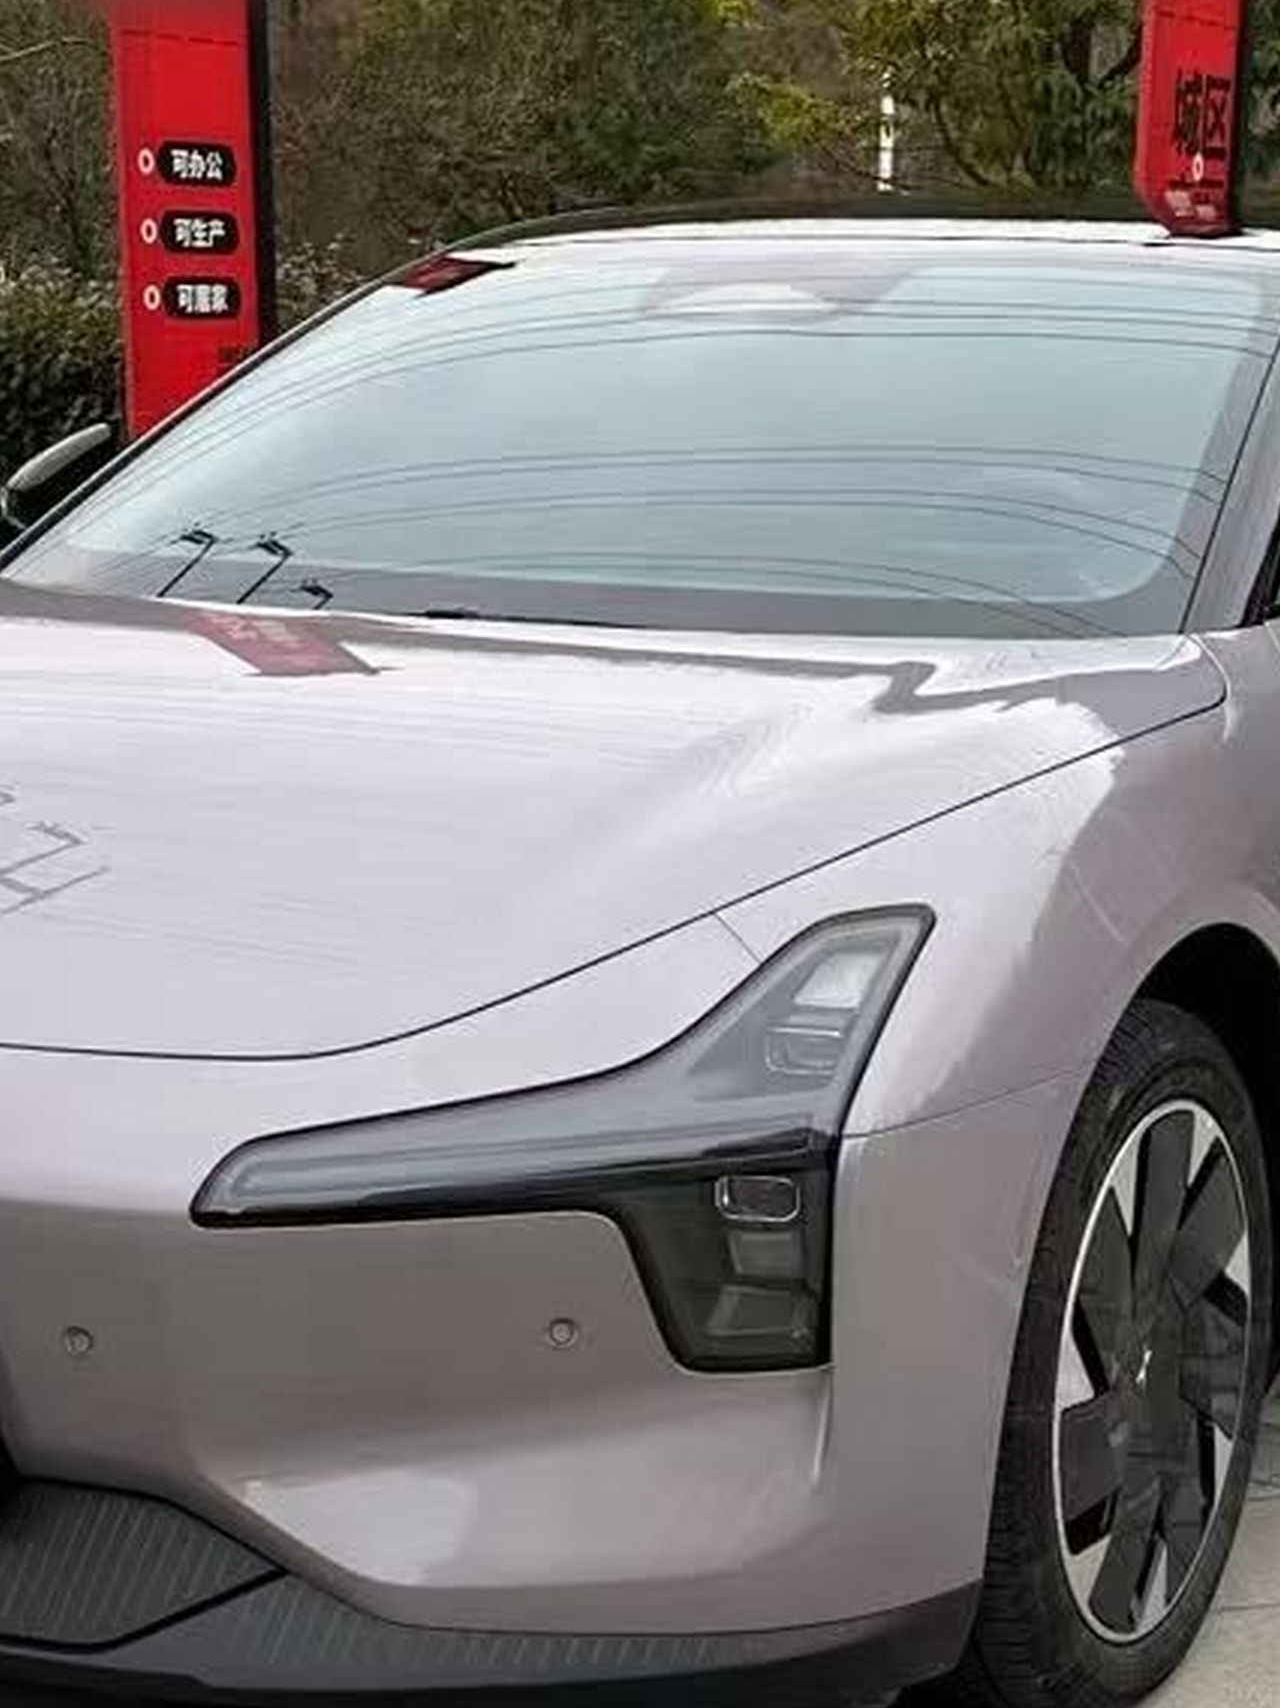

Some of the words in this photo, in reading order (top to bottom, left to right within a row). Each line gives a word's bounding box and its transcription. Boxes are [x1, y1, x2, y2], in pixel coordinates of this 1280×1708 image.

[170, 149, 223, 180] 可办公
[173, 218, 225, 248] 可生产
